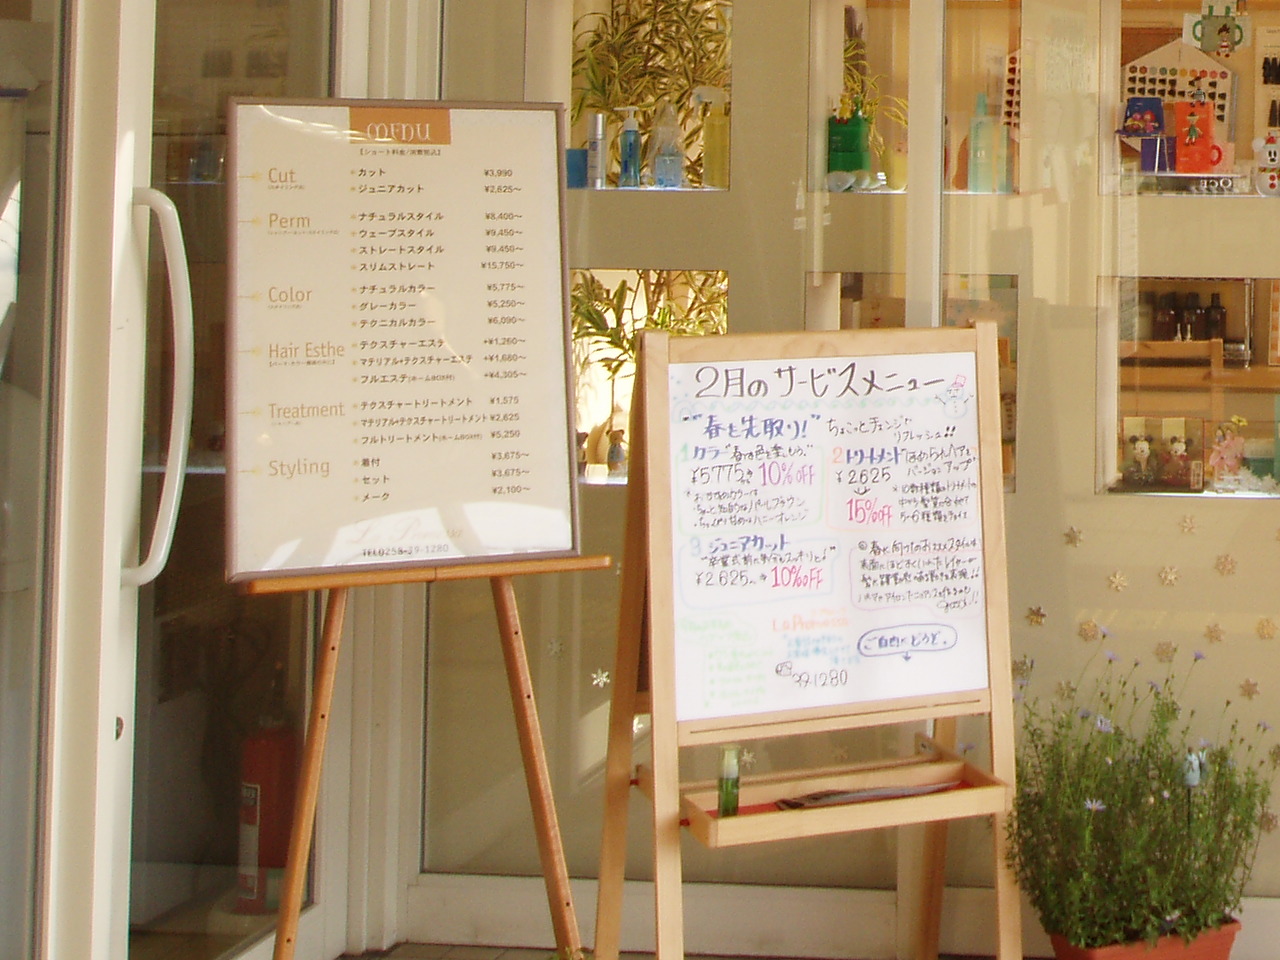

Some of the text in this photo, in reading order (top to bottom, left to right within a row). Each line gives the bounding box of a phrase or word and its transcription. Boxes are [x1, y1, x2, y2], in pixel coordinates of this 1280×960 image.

[367, 121, 432, 142] MENU
[268, 167, 297, 184] Cut
[358, 167, 386, 177] カット
[358, 183, 424, 194] ジュニアカット
[268, 213, 311, 228] Perm
[358, 212, 444, 222] ナチュラルスタイル
[359, 228, 435, 238] ウェーブスタイル
[359, 244, 445, 255] ストレートスタイル
[359, 261, 435, 271] スリムストレート
[359, 283, 436, 294] ナチュラルカラー
[268, 286, 313, 303] Color
[359, 317, 436, 328] テクニカルカラー
[268, 342, 345, 359] Hair Esthe
[695, 362, 946, 400] 2月のサービスメニュー
[268, 402, 346, 419] Treatment
[832, 446, 845, 465] 2
[361, 457, 381, 468] 着付
[268, 460, 331, 478] Styling
[362, 474, 390, 485] セット
[362, 491, 390, 502] メーク
